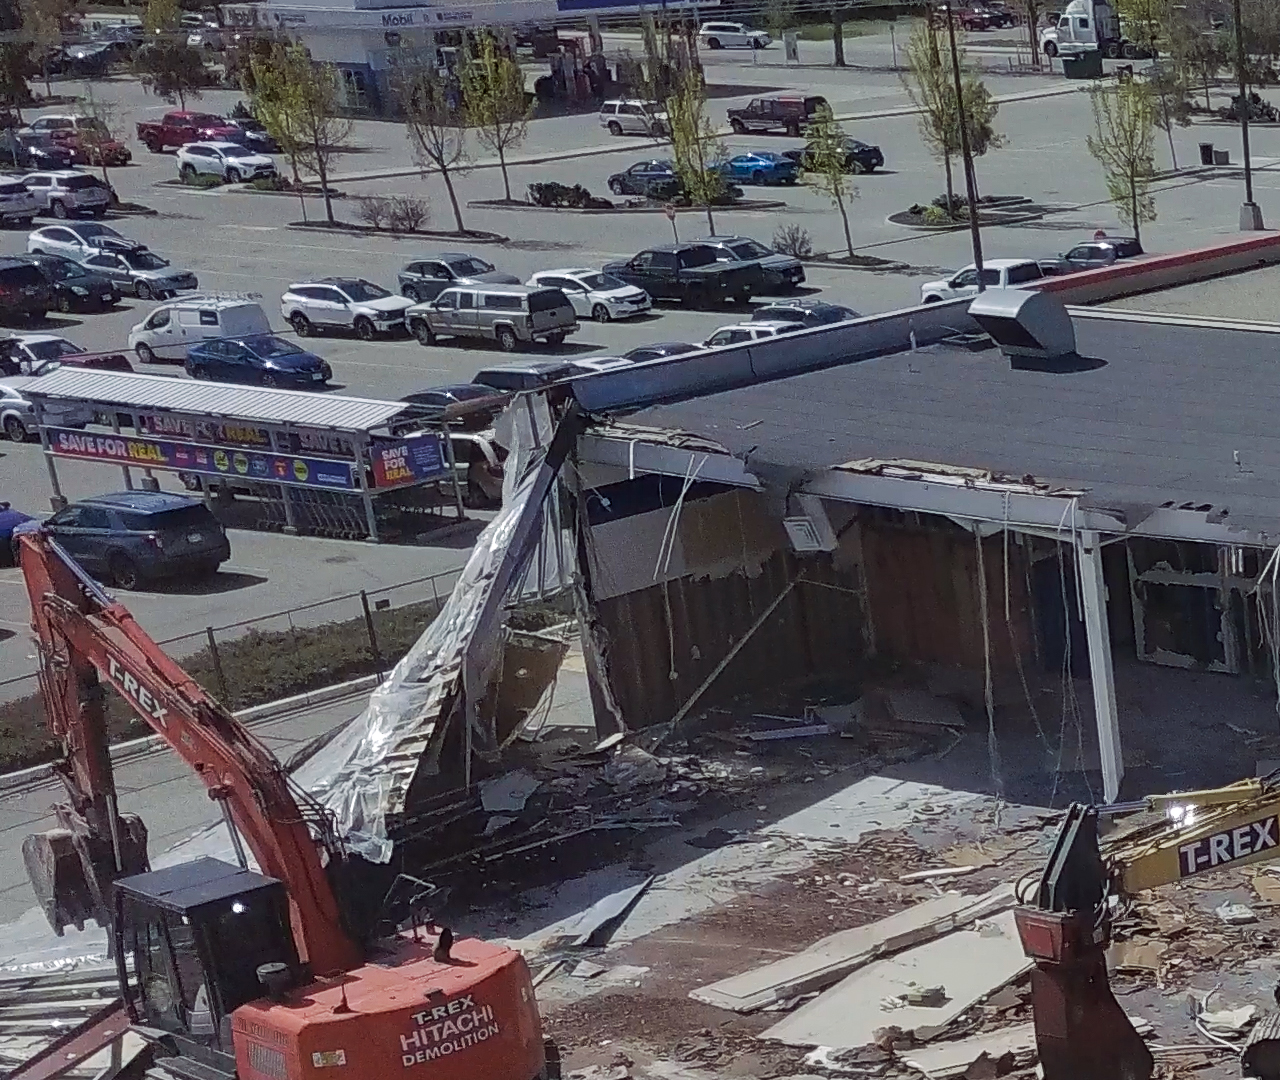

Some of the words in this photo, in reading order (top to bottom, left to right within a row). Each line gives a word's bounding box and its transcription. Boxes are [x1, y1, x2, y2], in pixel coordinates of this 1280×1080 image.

[382, 13, 414, 26] Mobil
[58, 433, 95, 453] SAVE
[96, 437, 128, 457] FOR
[127, 441, 167, 462] REAL
[381, 446, 409, 460] SAVE
[384, 457, 406, 470] FOR
[106, 653, 168, 729] T-REX
[1180, 817, 1277, 873] T-REX
[411, 994, 475, 1025] T-REX
[400, 1004, 494, 1051] HITACHI
[402, 1021, 500, 1067] DEMOLITION
